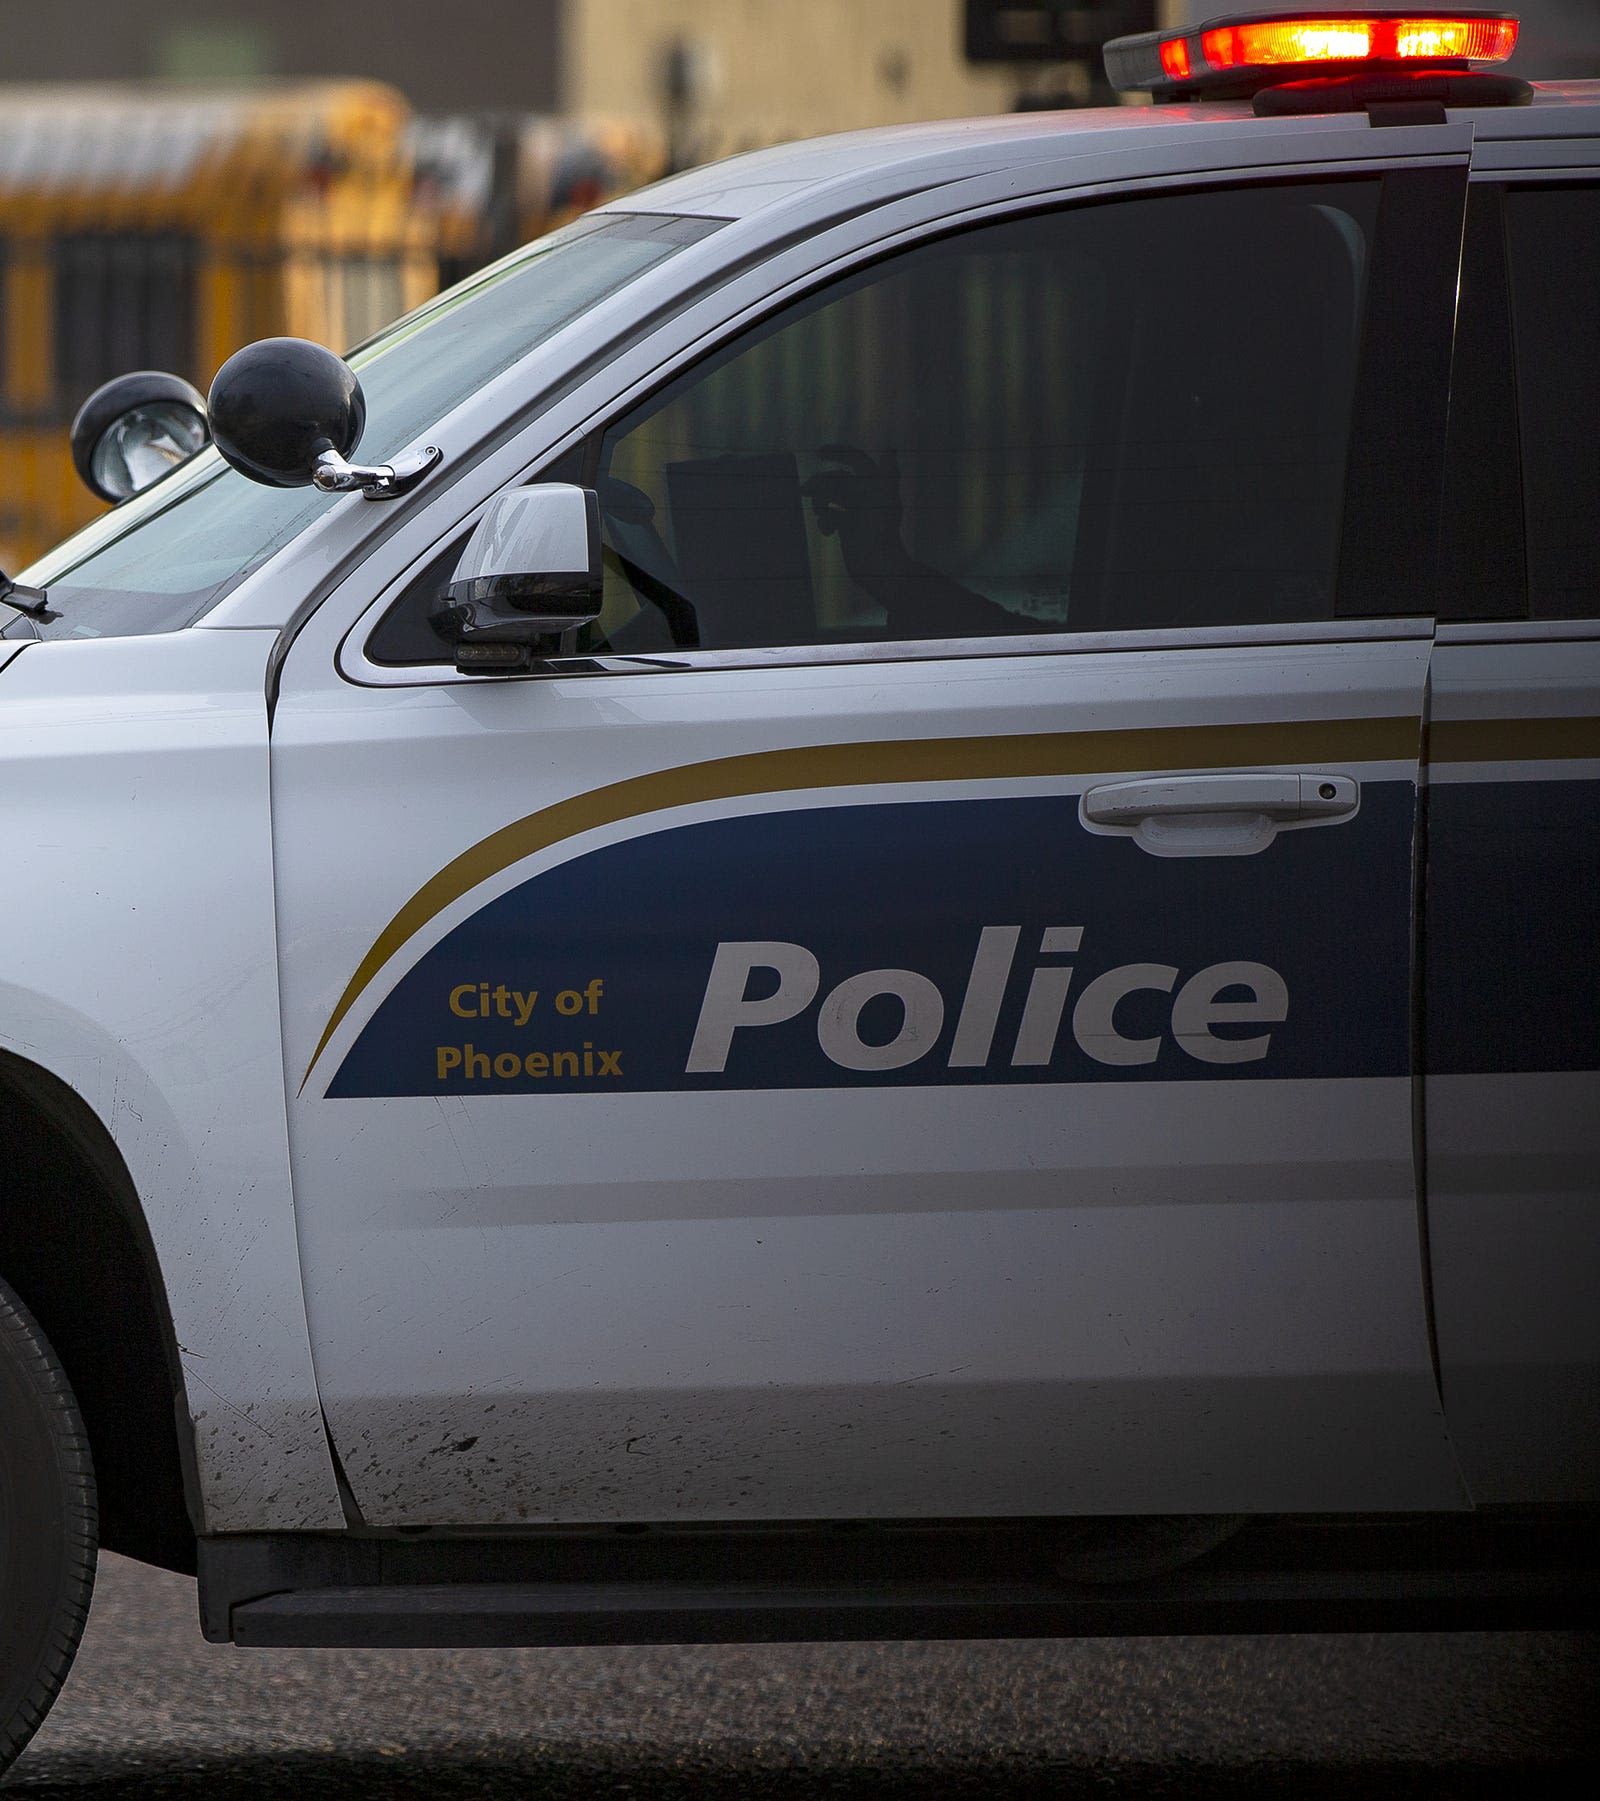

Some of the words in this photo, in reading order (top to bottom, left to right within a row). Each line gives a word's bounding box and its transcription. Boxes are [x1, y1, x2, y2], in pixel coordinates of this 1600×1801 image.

[449, 982, 539, 1026] City
[554, 979, 604, 1016] of
[685, 925, 1289, 1072] Police
[436, 1042, 624, 1079] Phoenix
